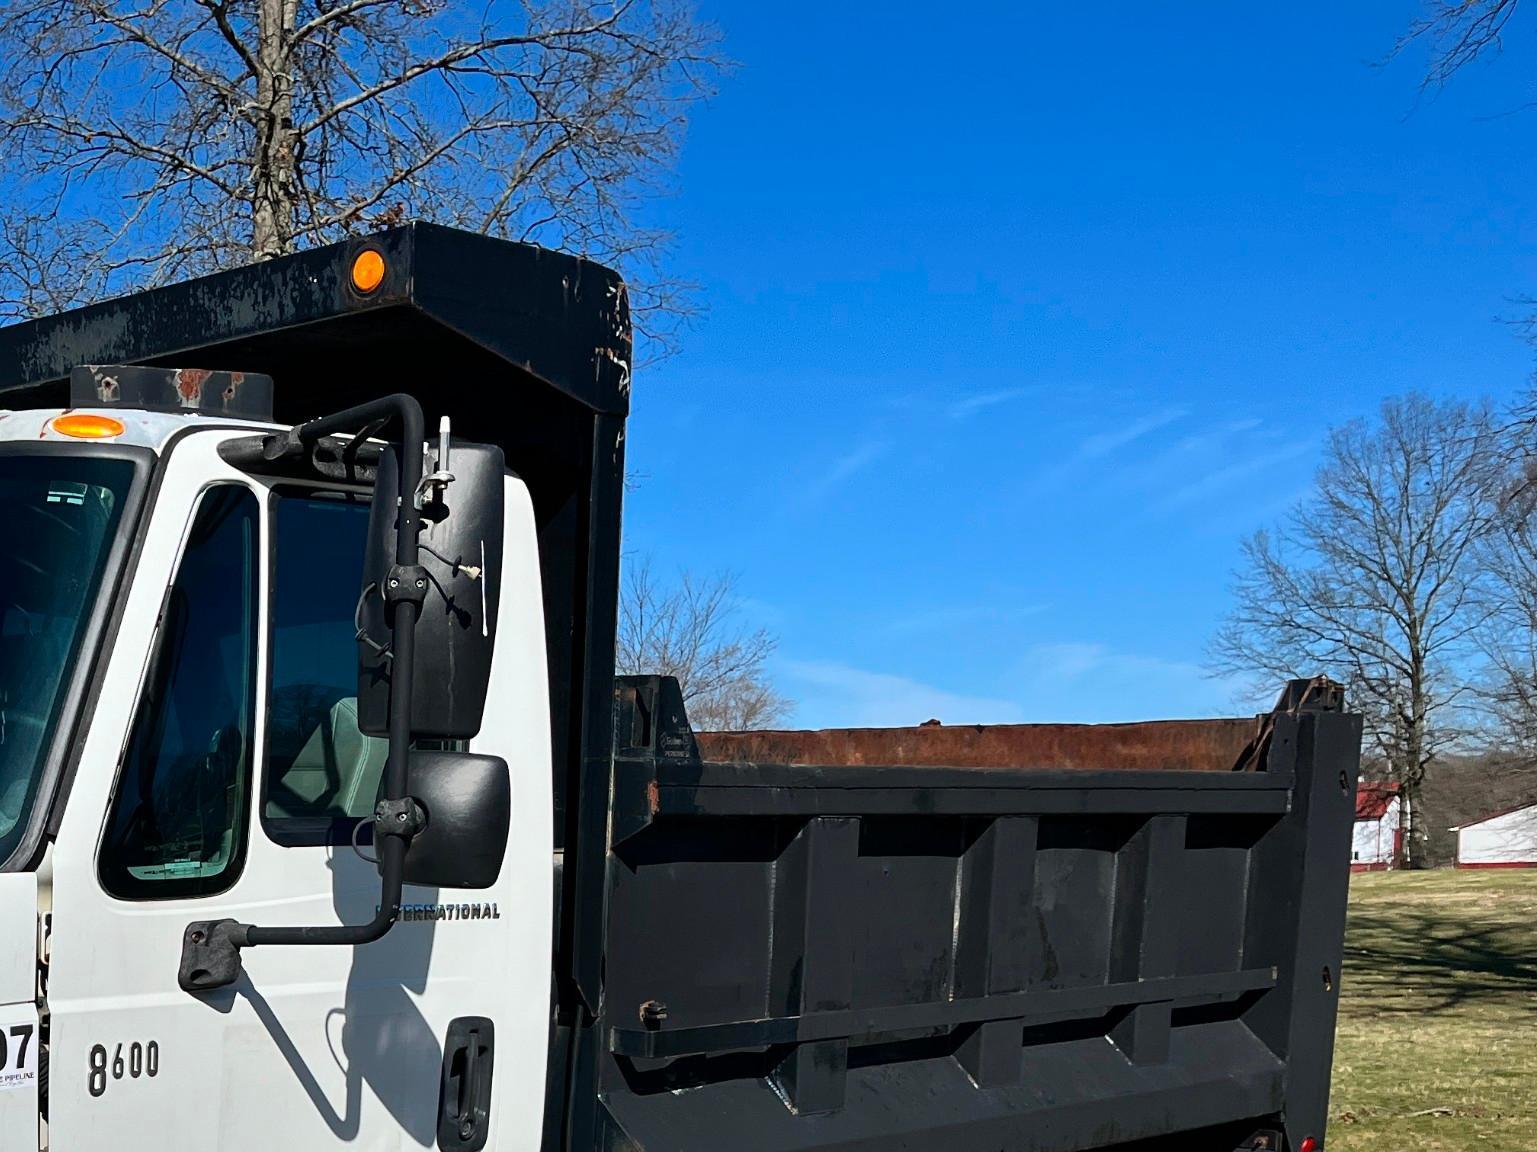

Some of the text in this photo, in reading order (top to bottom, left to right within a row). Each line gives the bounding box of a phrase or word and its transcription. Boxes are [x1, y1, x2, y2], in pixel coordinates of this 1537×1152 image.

[375, 902, 501, 921] ITERNATIONAL
[4, 1071, 35, 1082] PIPELINE
[87, 1039, 160, 1099] 8600
